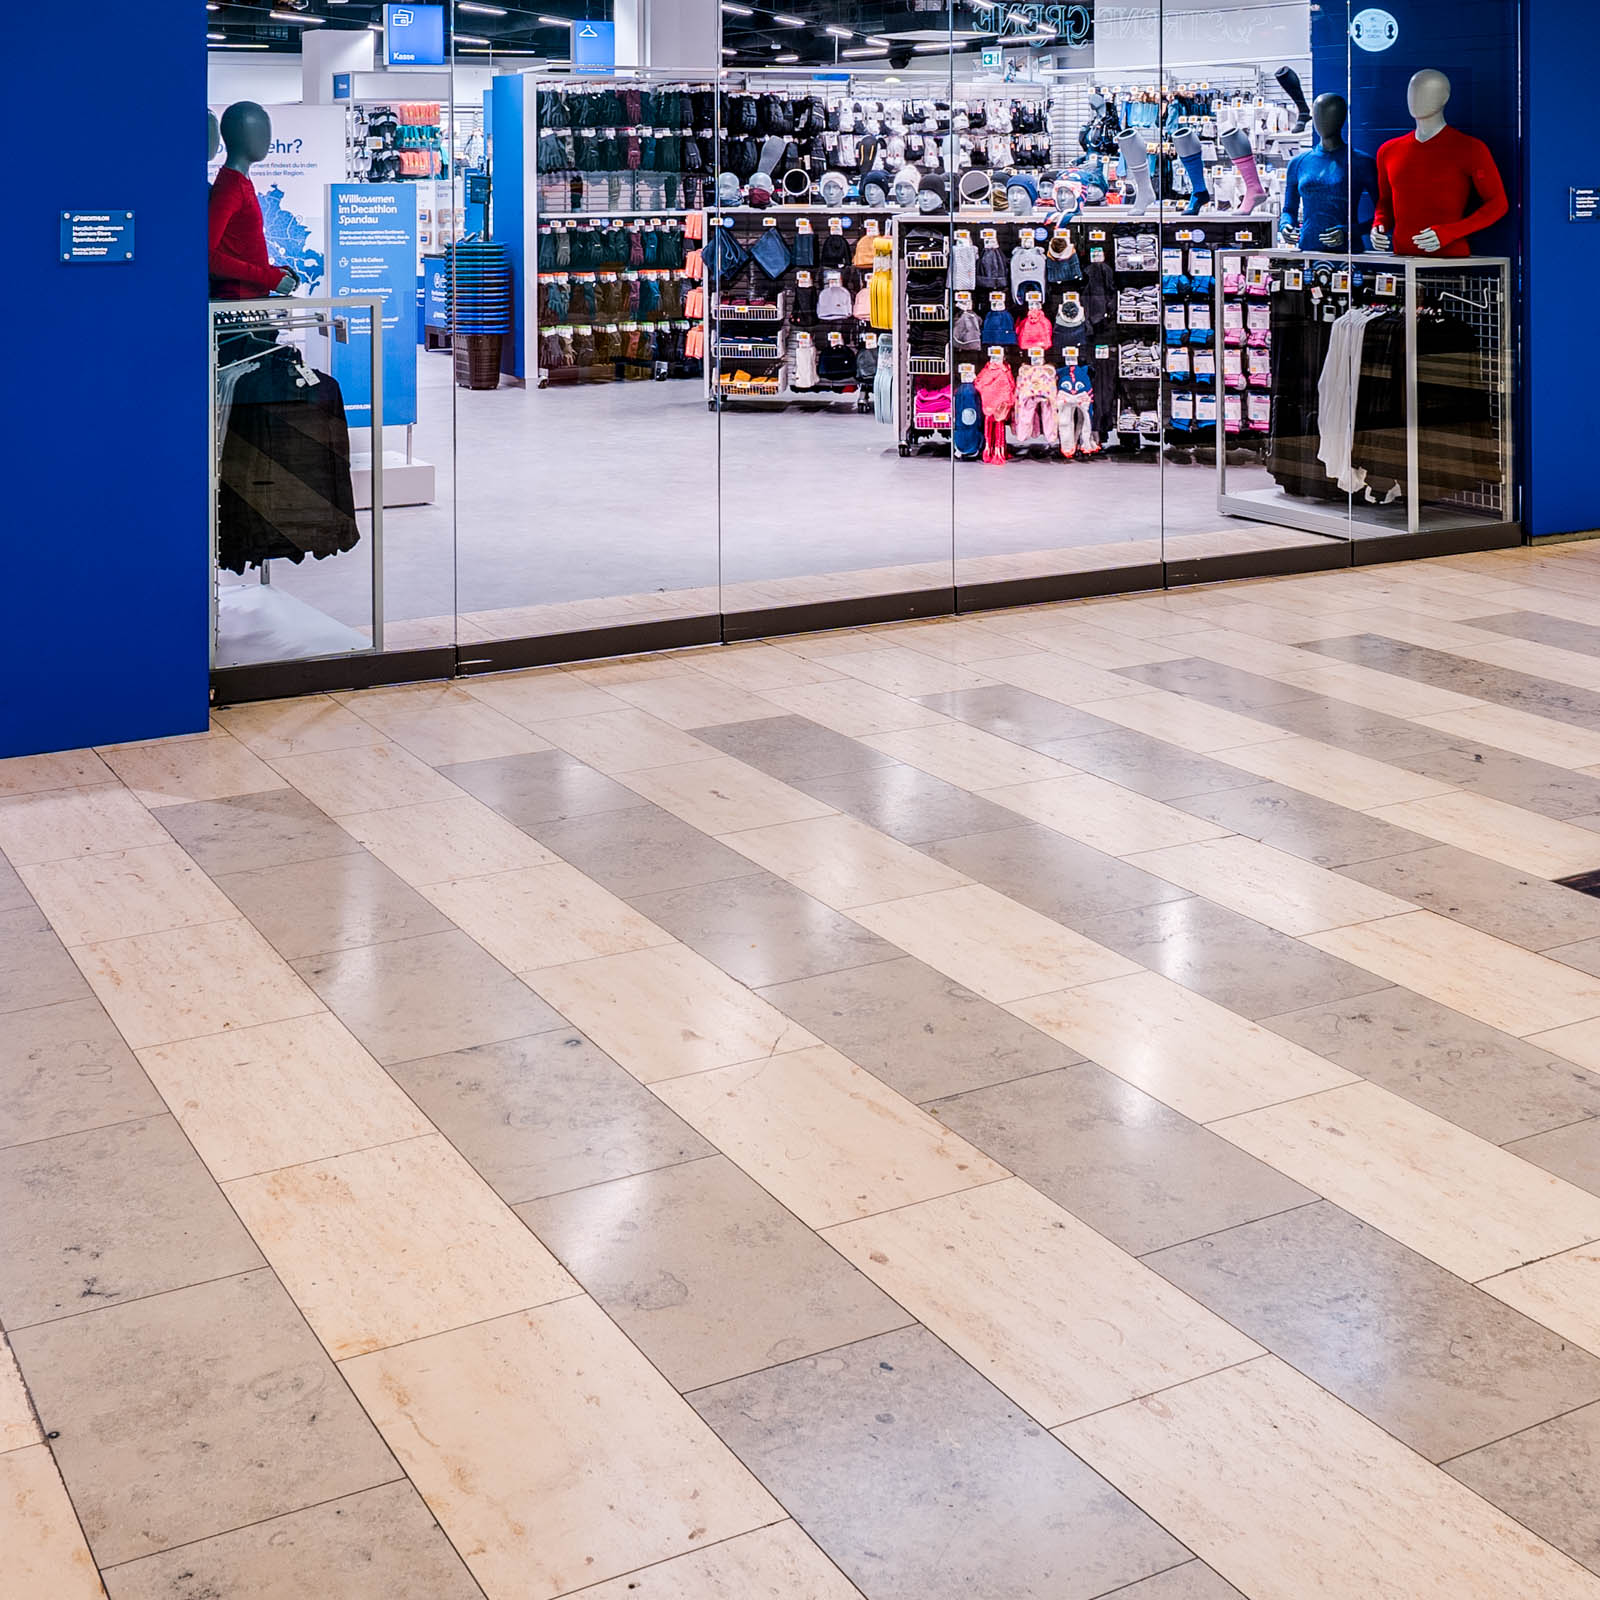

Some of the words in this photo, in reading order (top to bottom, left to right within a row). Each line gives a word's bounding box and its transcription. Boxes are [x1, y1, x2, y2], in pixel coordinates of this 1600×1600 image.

[393, 52, 415, 61] Kasse
[268, 138, 303, 154] ehr?
[338, 194, 395, 203] Willkommen
[338, 204, 350, 214] im
[351, 204, 397, 214] Decathlon
[338, 215, 379, 226] Spandau
